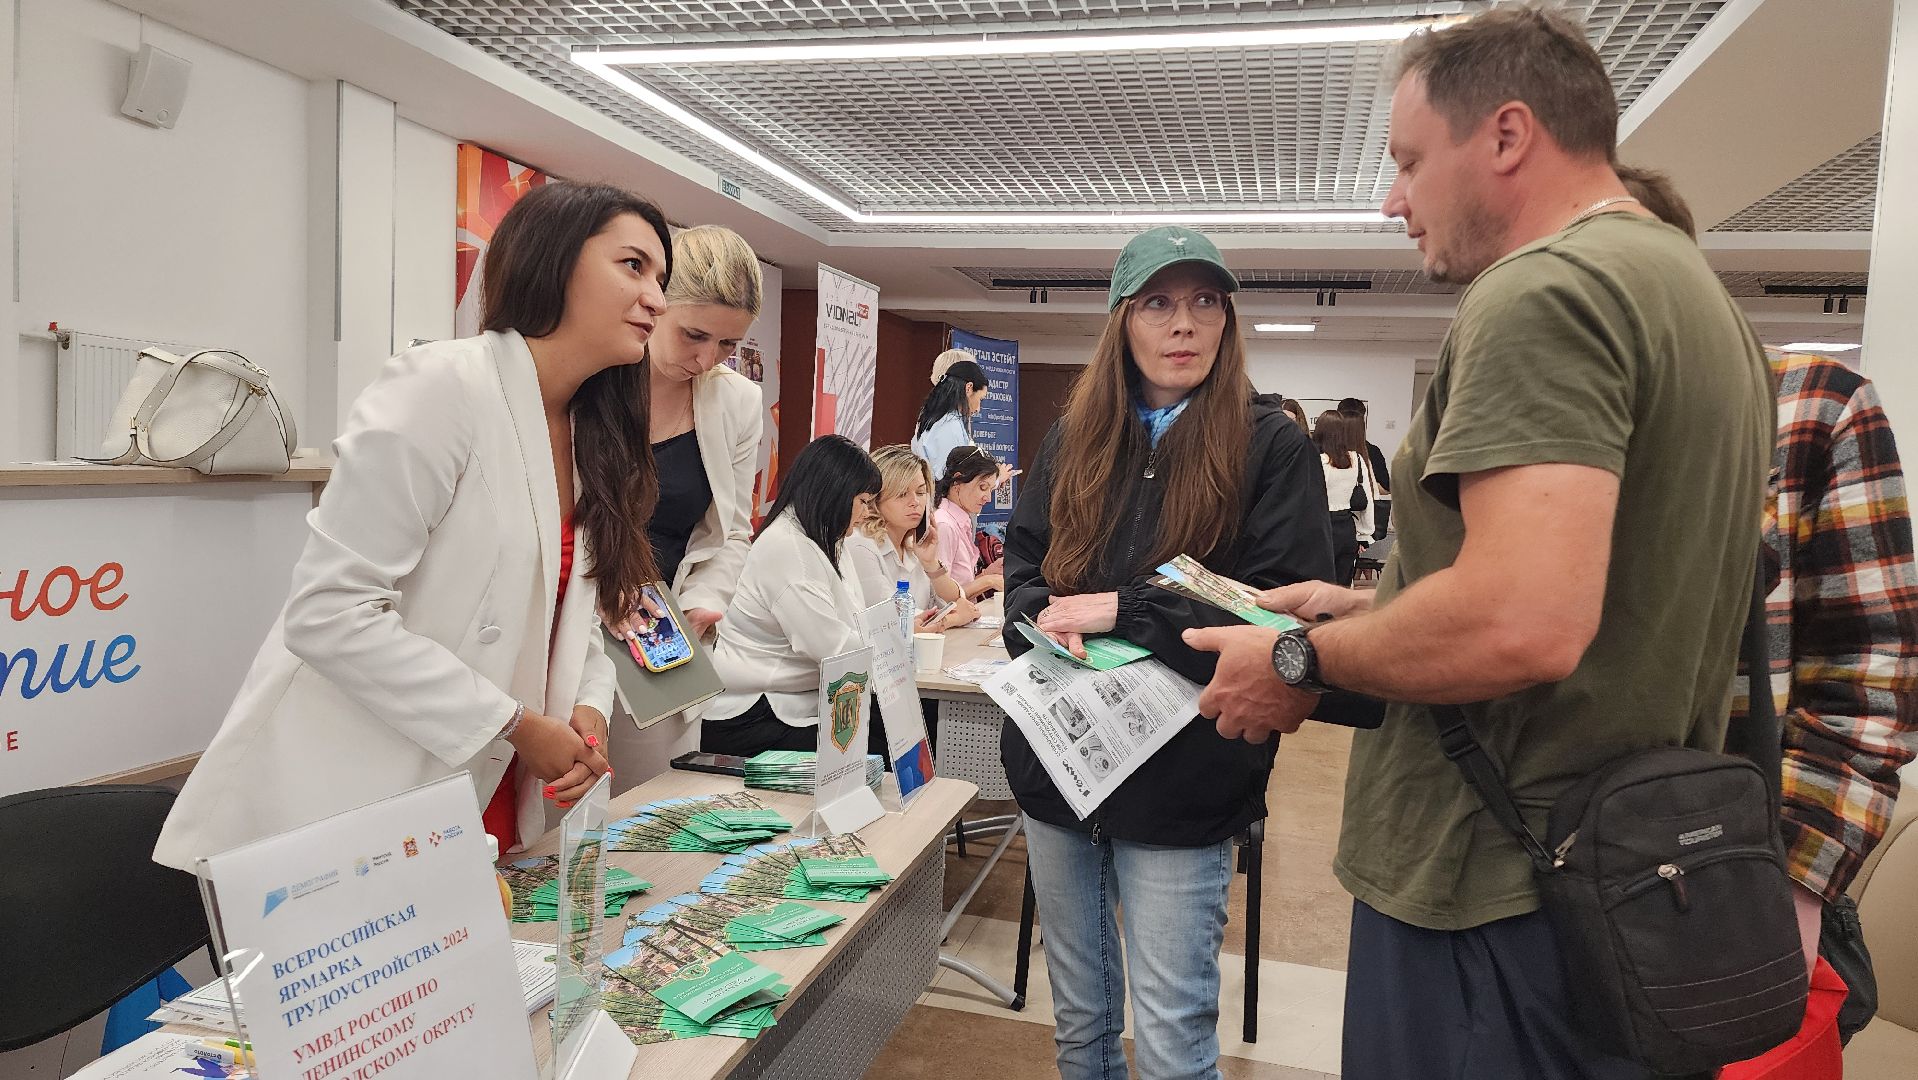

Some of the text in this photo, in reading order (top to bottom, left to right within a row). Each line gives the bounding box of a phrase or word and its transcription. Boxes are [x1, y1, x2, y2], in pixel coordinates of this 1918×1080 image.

[991, 351, 1016, 366] ЭСТЕЙТ
[272, 904, 417, 980] ВСЕРОССИЙСКАЯ
[279, 954, 363, 1004] ЯРМАРКА
[282, 926, 469, 1028] ТРУДОУСТРОЙСТВА 2024
[292, 977, 438, 1064] УМВД РОССИИ ПО
[422, 1002, 477, 1045] ОКРУГУ
